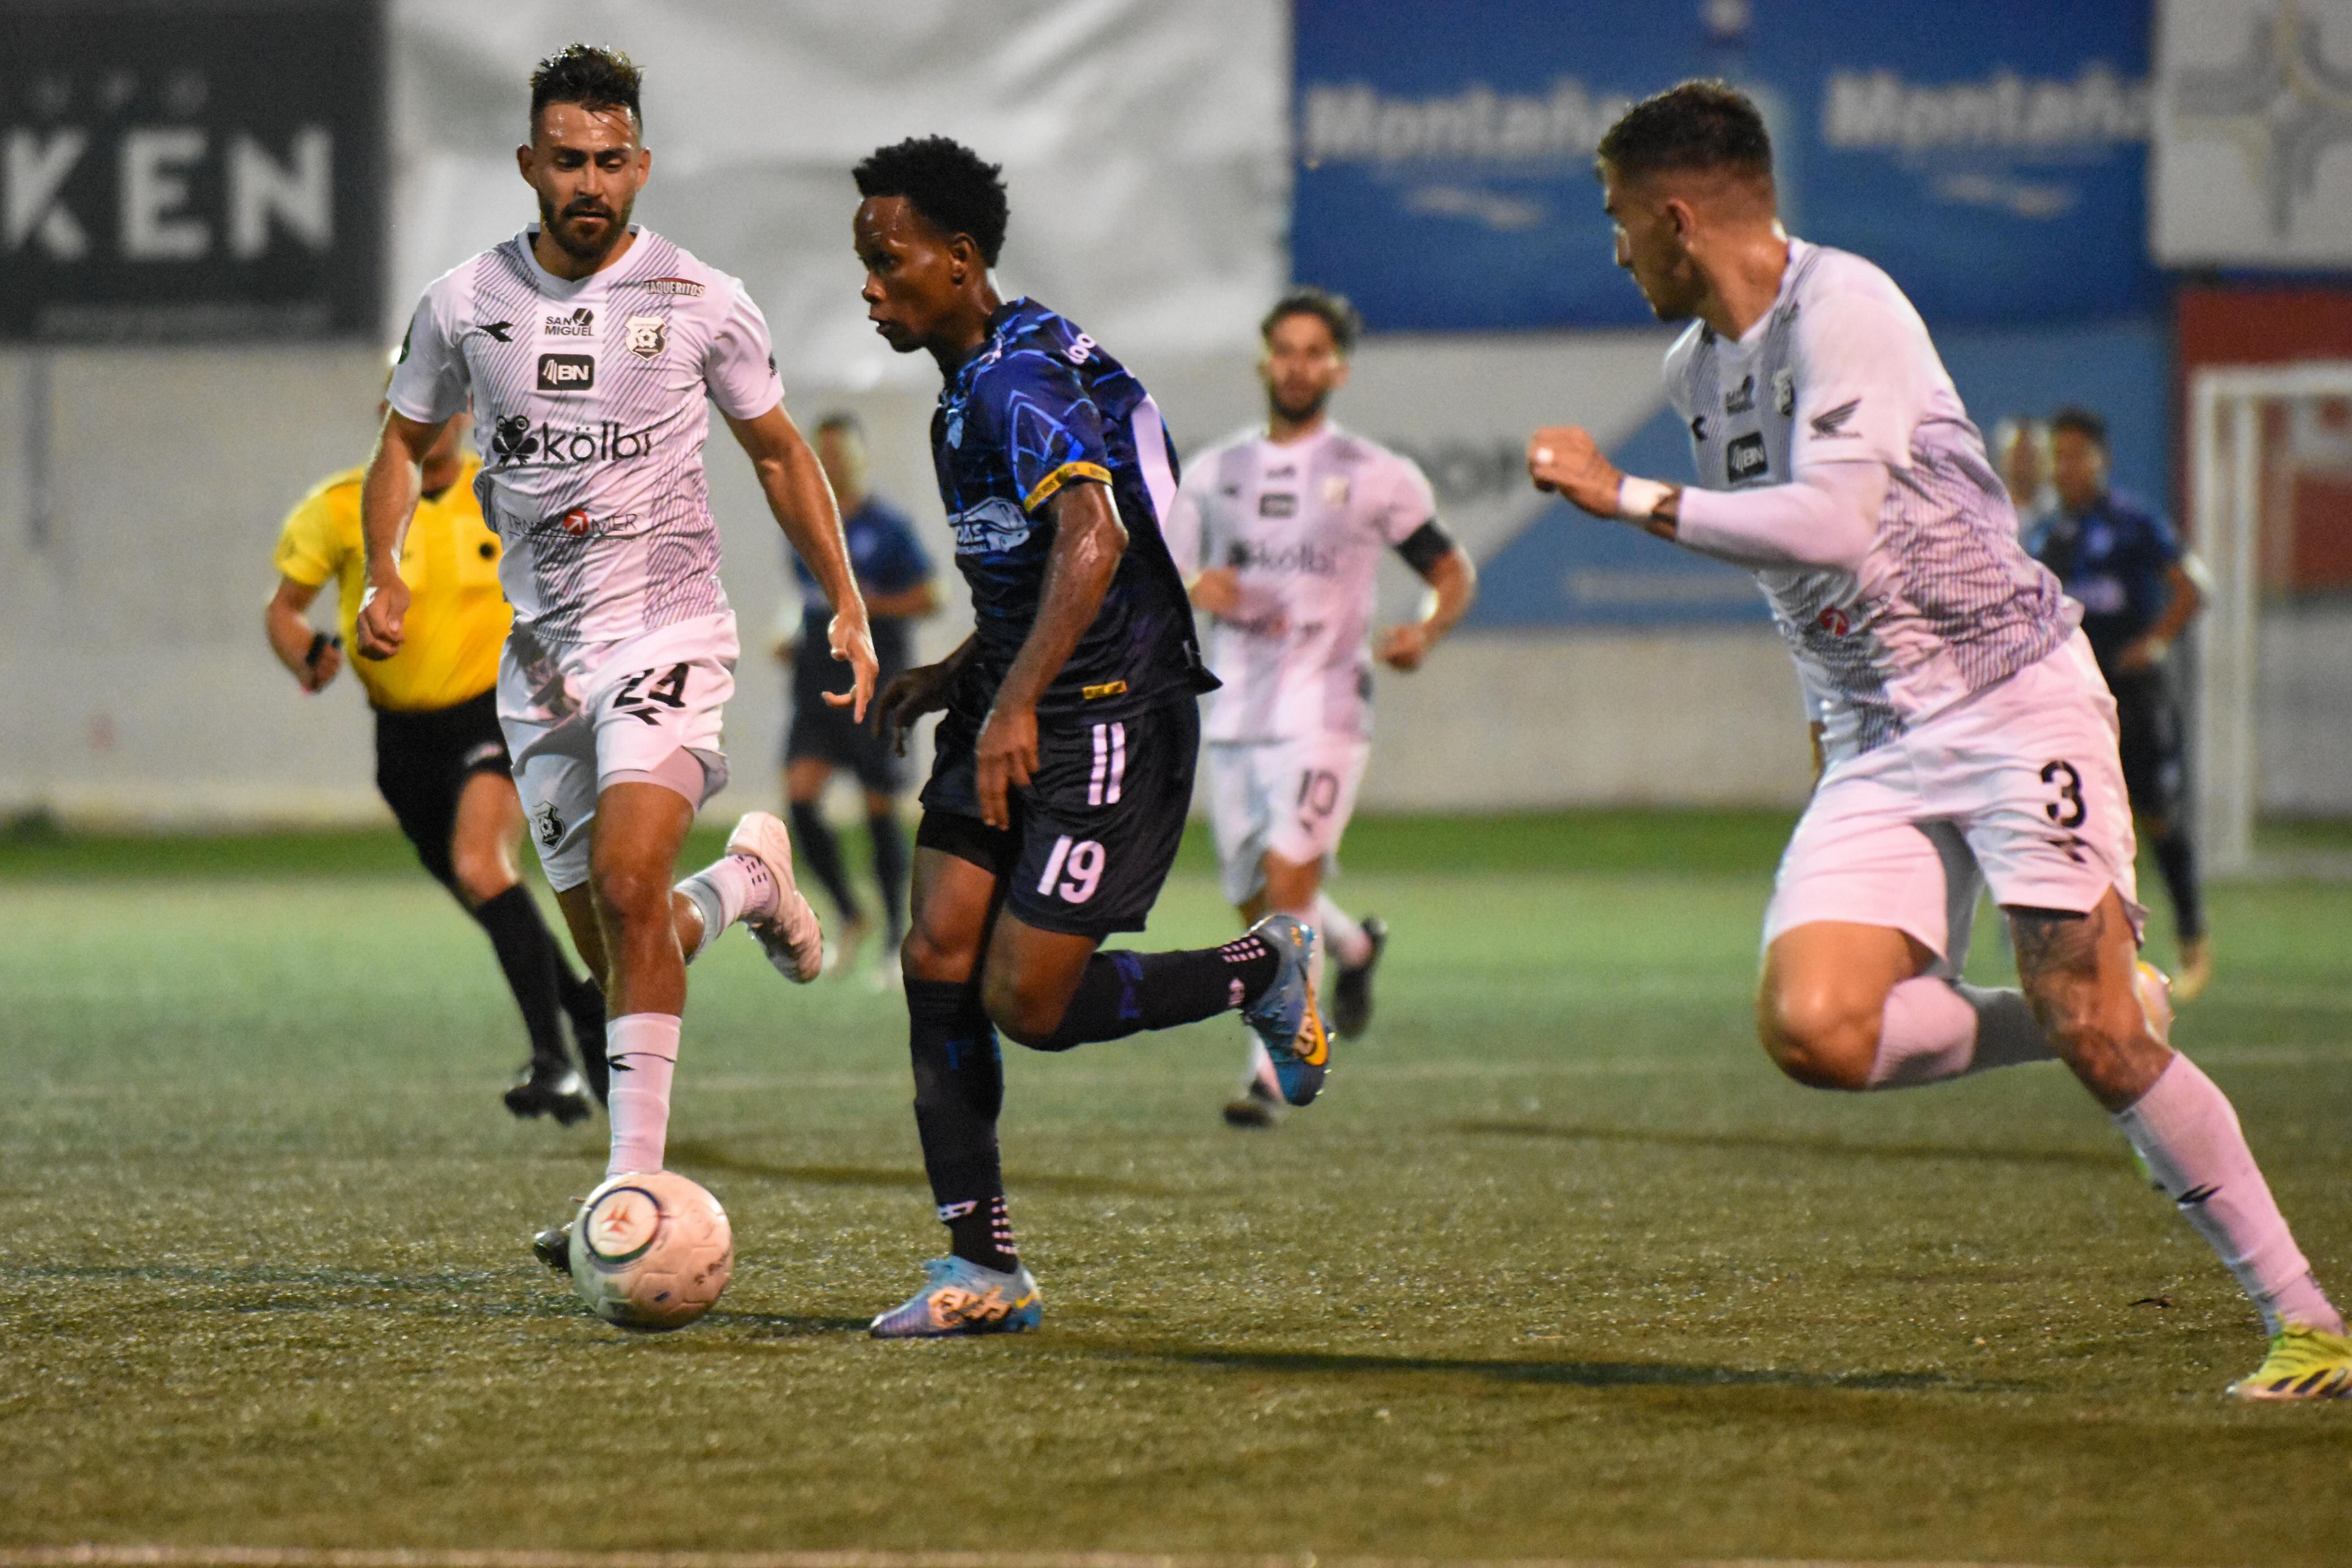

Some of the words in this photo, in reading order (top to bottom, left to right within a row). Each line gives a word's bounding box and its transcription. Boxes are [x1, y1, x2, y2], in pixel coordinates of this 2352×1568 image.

[6, 125, 335, 261] KEN
[644, 281, 706, 298] TAQUERITOS
[544, 326, 595, 336] MIGUEL
[546, 316, 573, 326] SAN
[558, 365, 589, 380] BN
[613, 662, 688, 709] 24
[1297, 769, 1340, 816] 10
[2040, 761, 2087, 829] 3
[1036, 834, 1106, 904] 19
